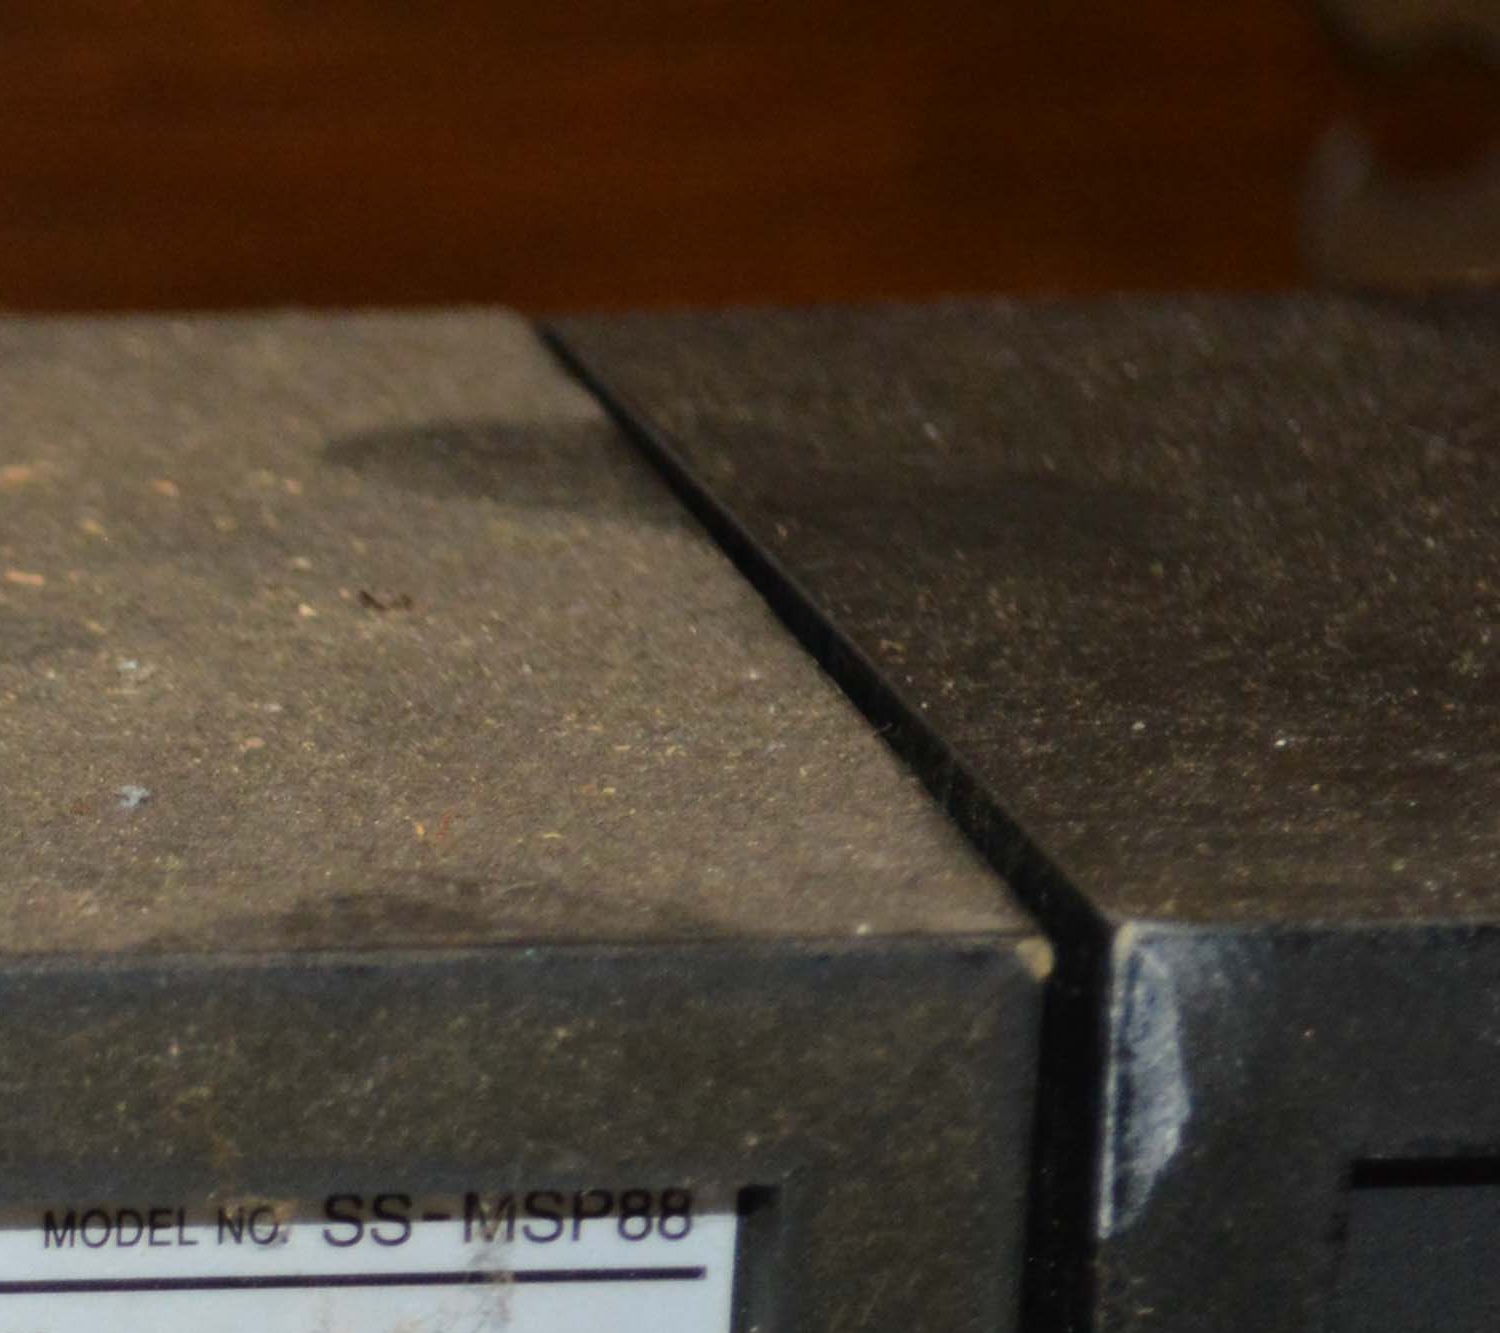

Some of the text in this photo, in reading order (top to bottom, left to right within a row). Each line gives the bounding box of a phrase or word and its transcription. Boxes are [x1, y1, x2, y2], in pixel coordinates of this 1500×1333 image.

[42, 1187, 694, 1249] MODEL NO. SS-MSP88
